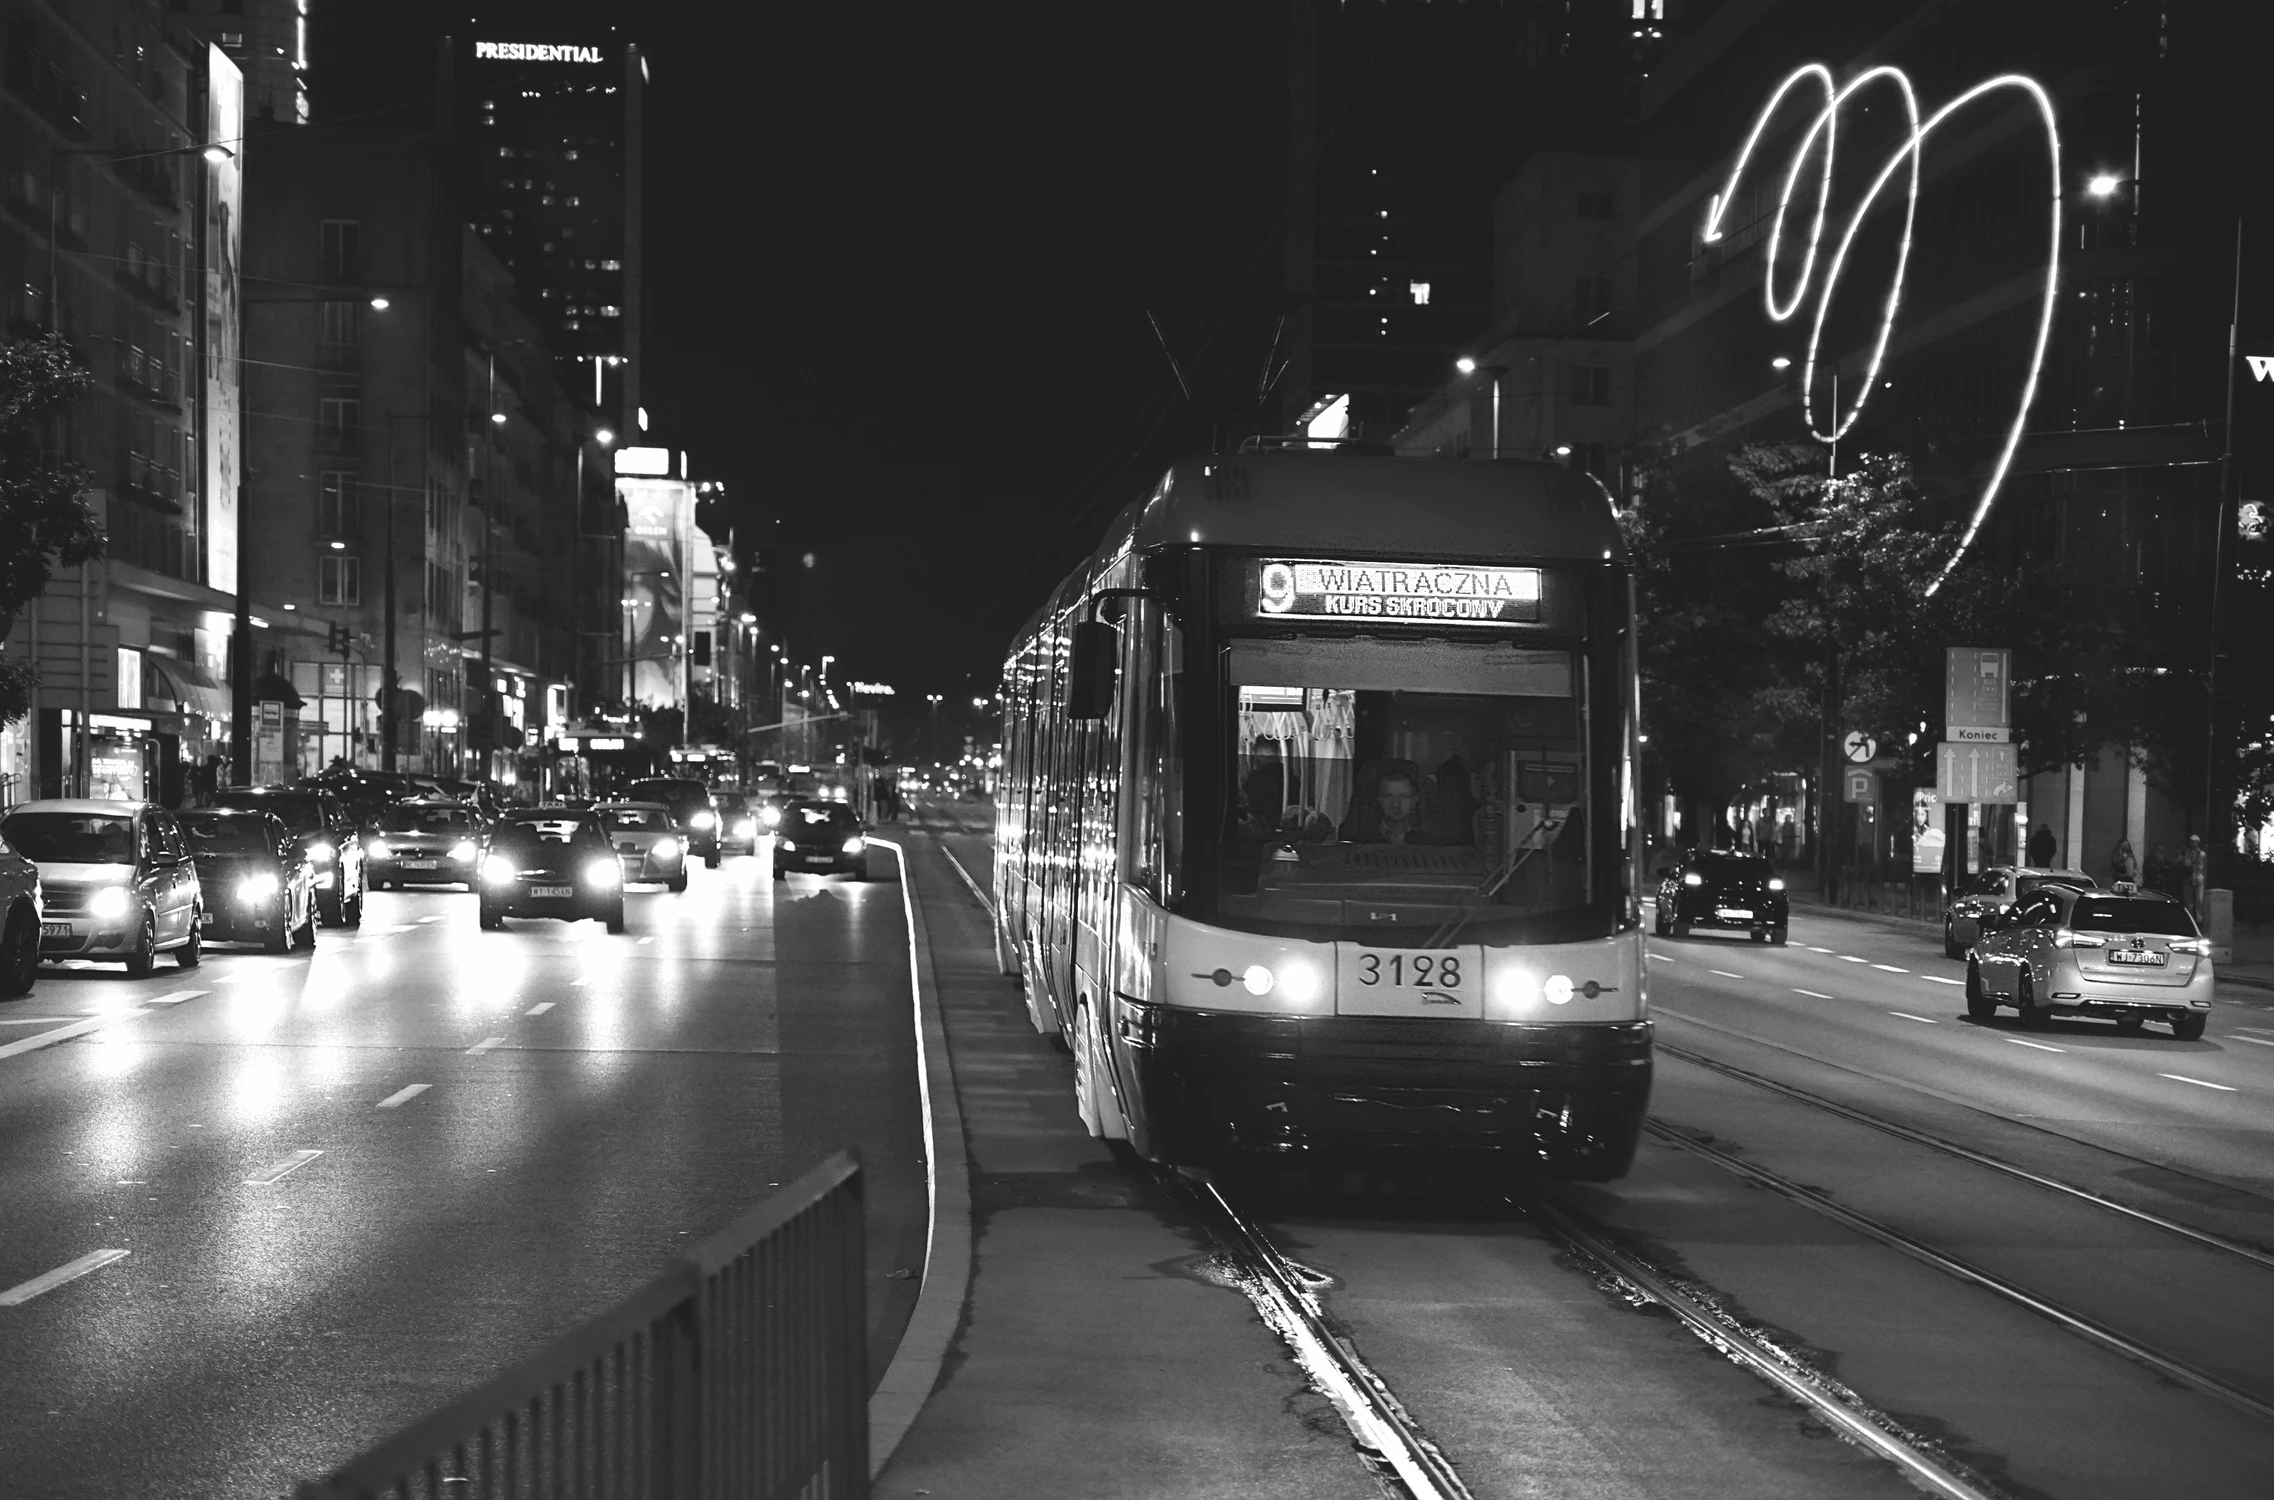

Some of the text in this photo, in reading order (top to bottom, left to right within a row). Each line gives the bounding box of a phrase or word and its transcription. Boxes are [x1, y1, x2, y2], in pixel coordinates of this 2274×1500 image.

[475, 41, 604, 63] PRESIDENTIAL
[1262, 563, 1297, 613] 9
[1318, 569, 1513, 595] WIATRACZNA
[1325, 595, 1383, 614] KURS
[1959, 729, 1998, 740] Koniec
[1358, 953, 1461, 988] 3128
